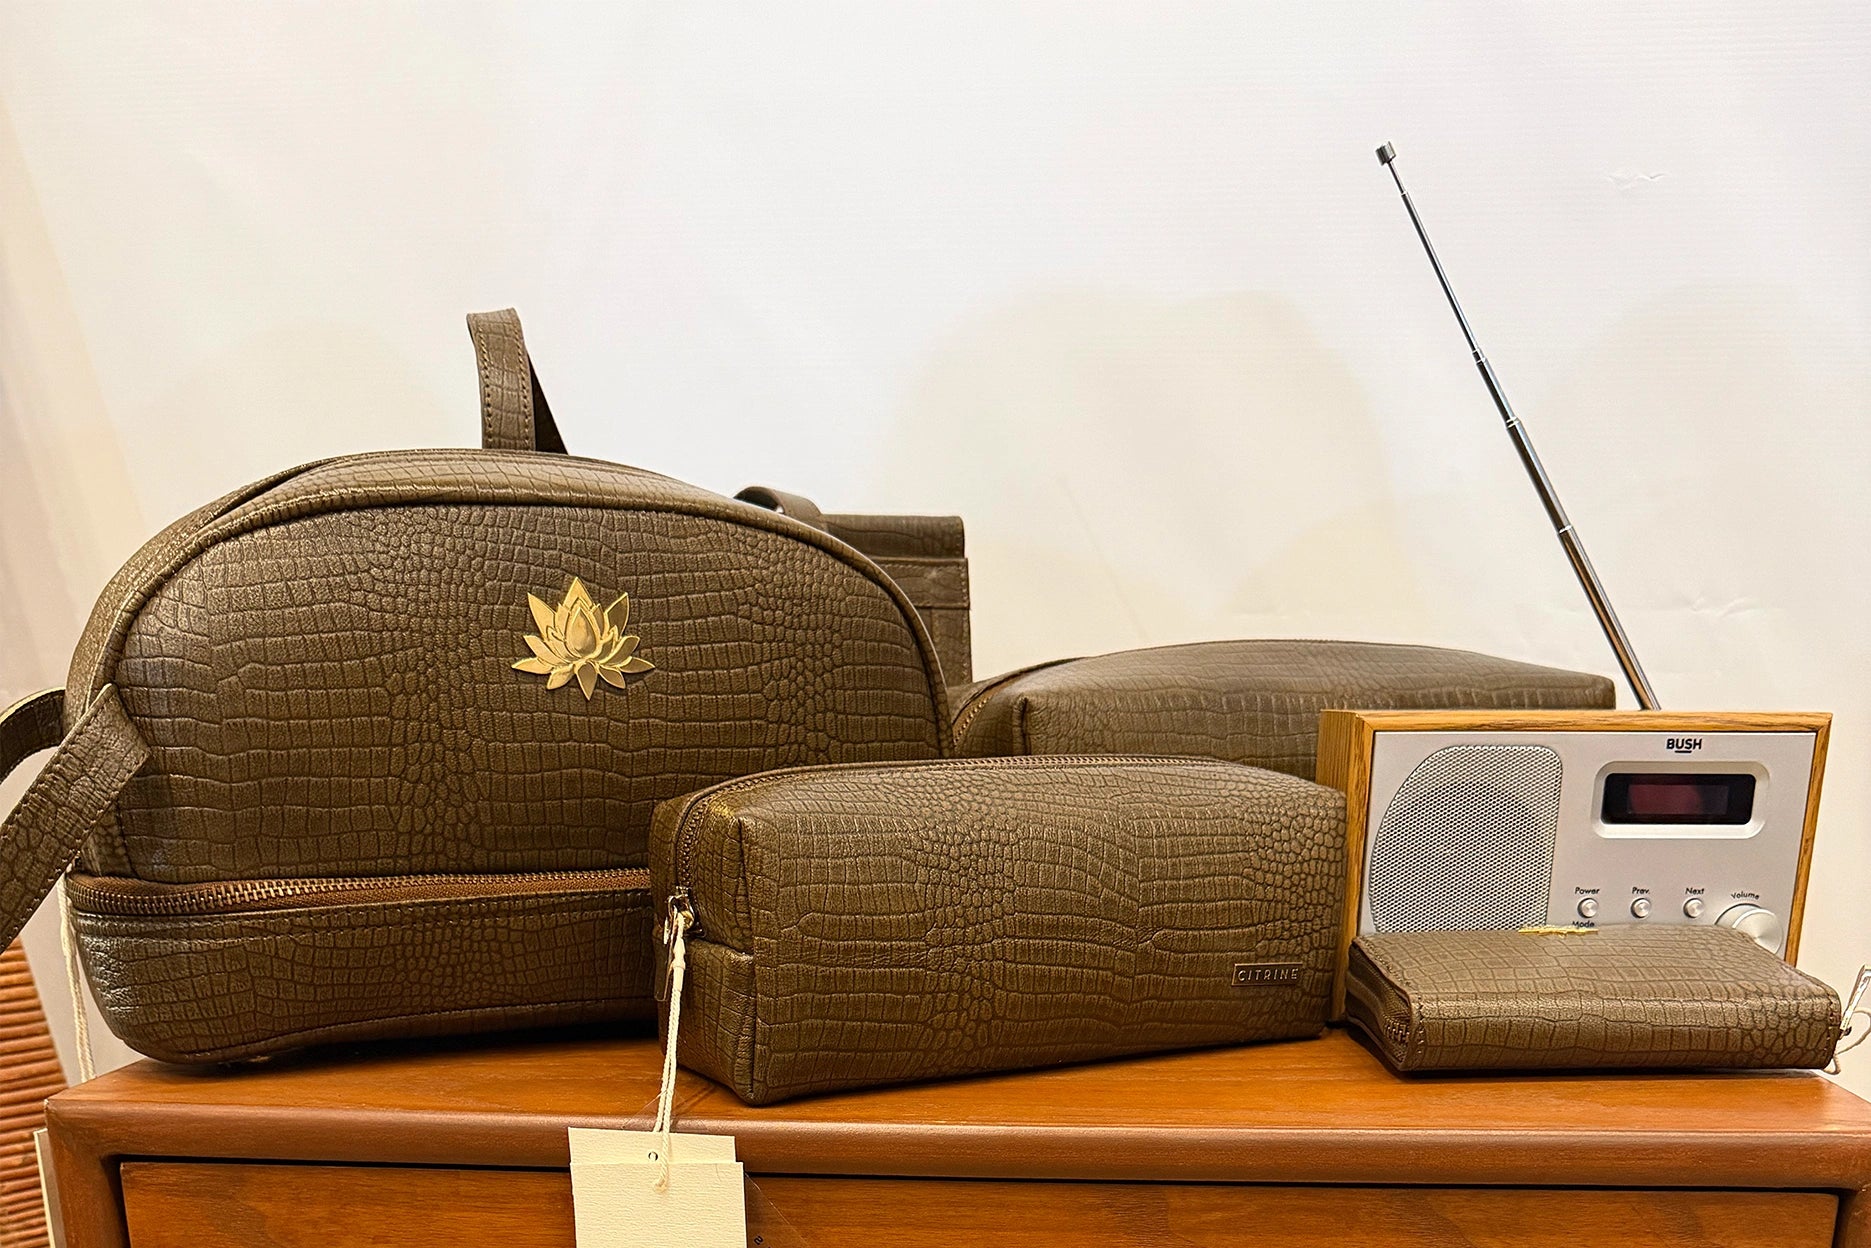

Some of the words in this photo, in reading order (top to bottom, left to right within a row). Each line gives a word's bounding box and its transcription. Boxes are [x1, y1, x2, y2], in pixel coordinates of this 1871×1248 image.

[1666, 738, 1703, 751] BUSH
[1574, 886, 1600, 895] Power
[1685, 886, 1705, 895] Next
[1731, 890, 1761, 901] Volume
[1237, 968, 1299, 982] CITRINE
